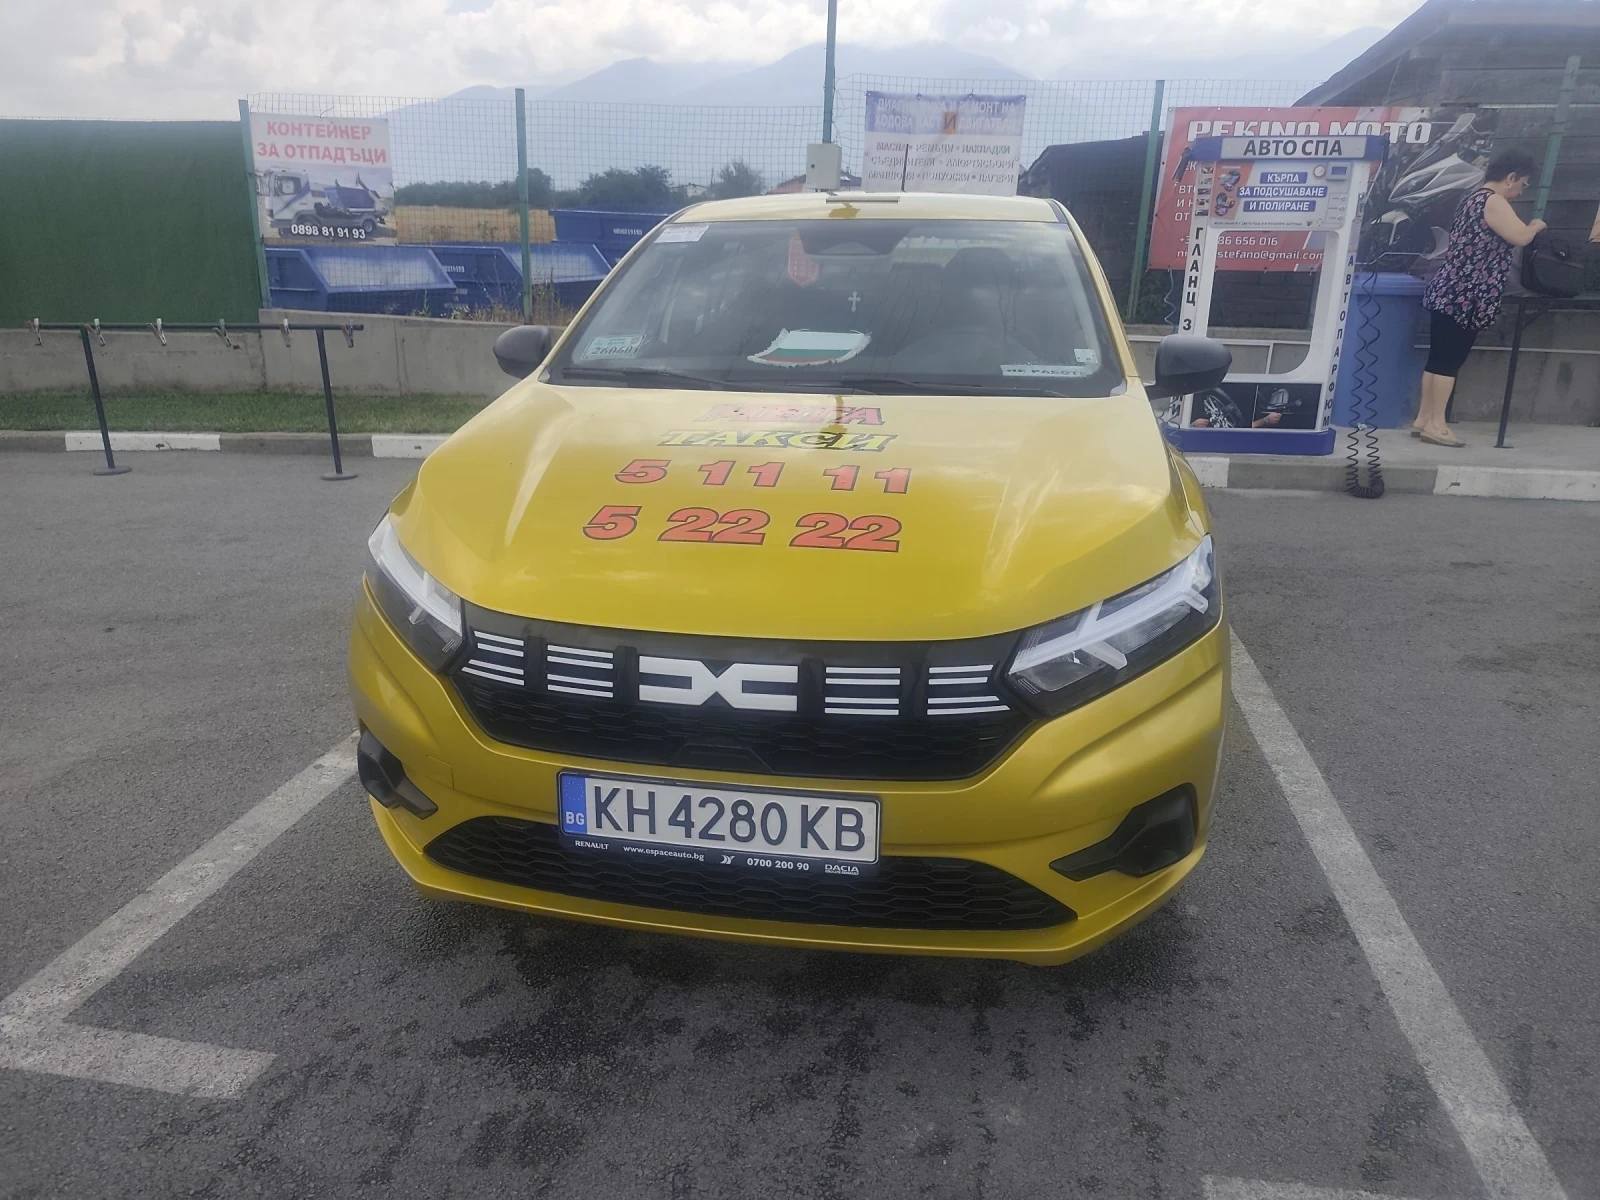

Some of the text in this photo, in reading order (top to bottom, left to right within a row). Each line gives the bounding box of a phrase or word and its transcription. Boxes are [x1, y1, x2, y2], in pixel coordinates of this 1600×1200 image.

[944, 114, 957, 130] И
[267, 121, 371, 140] КОНТЕЙНЕР
[1328, 121, 1432, 144] MOTO
[257, 142, 387, 165] ЗА ОТПАДЪЦИ
[1243, 140, 1343, 156] АВТО СПА
[1267, 173, 1300, 183] КЪРПА
[1239, 187, 1324, 198] ЗА ПОДСУШАВАНЕ
[1249, 202, 1310, 211] И ПОЛИРАНЕ
[291, 224, 366, 239] 0898 81 91 93
[1235, 236, 1256, 246] 656
[1259, 236, 1278, 246] 016
[657, 430, 899, 452] ТАКСИ
[615, 459, 671, 483] 5
[582, 505, 903, 553] 5 22 22
[565, 811, 585, 825] BG
[594, 785, 866, 851] KH 4280 KB
[575, 840, 610, 850] RENAULT
[623, 845, 705, 861] www.espaceauto.bg
[747, 857, 810, 871] 0700 200 90
[824, 864, 860, 873] DACIA
